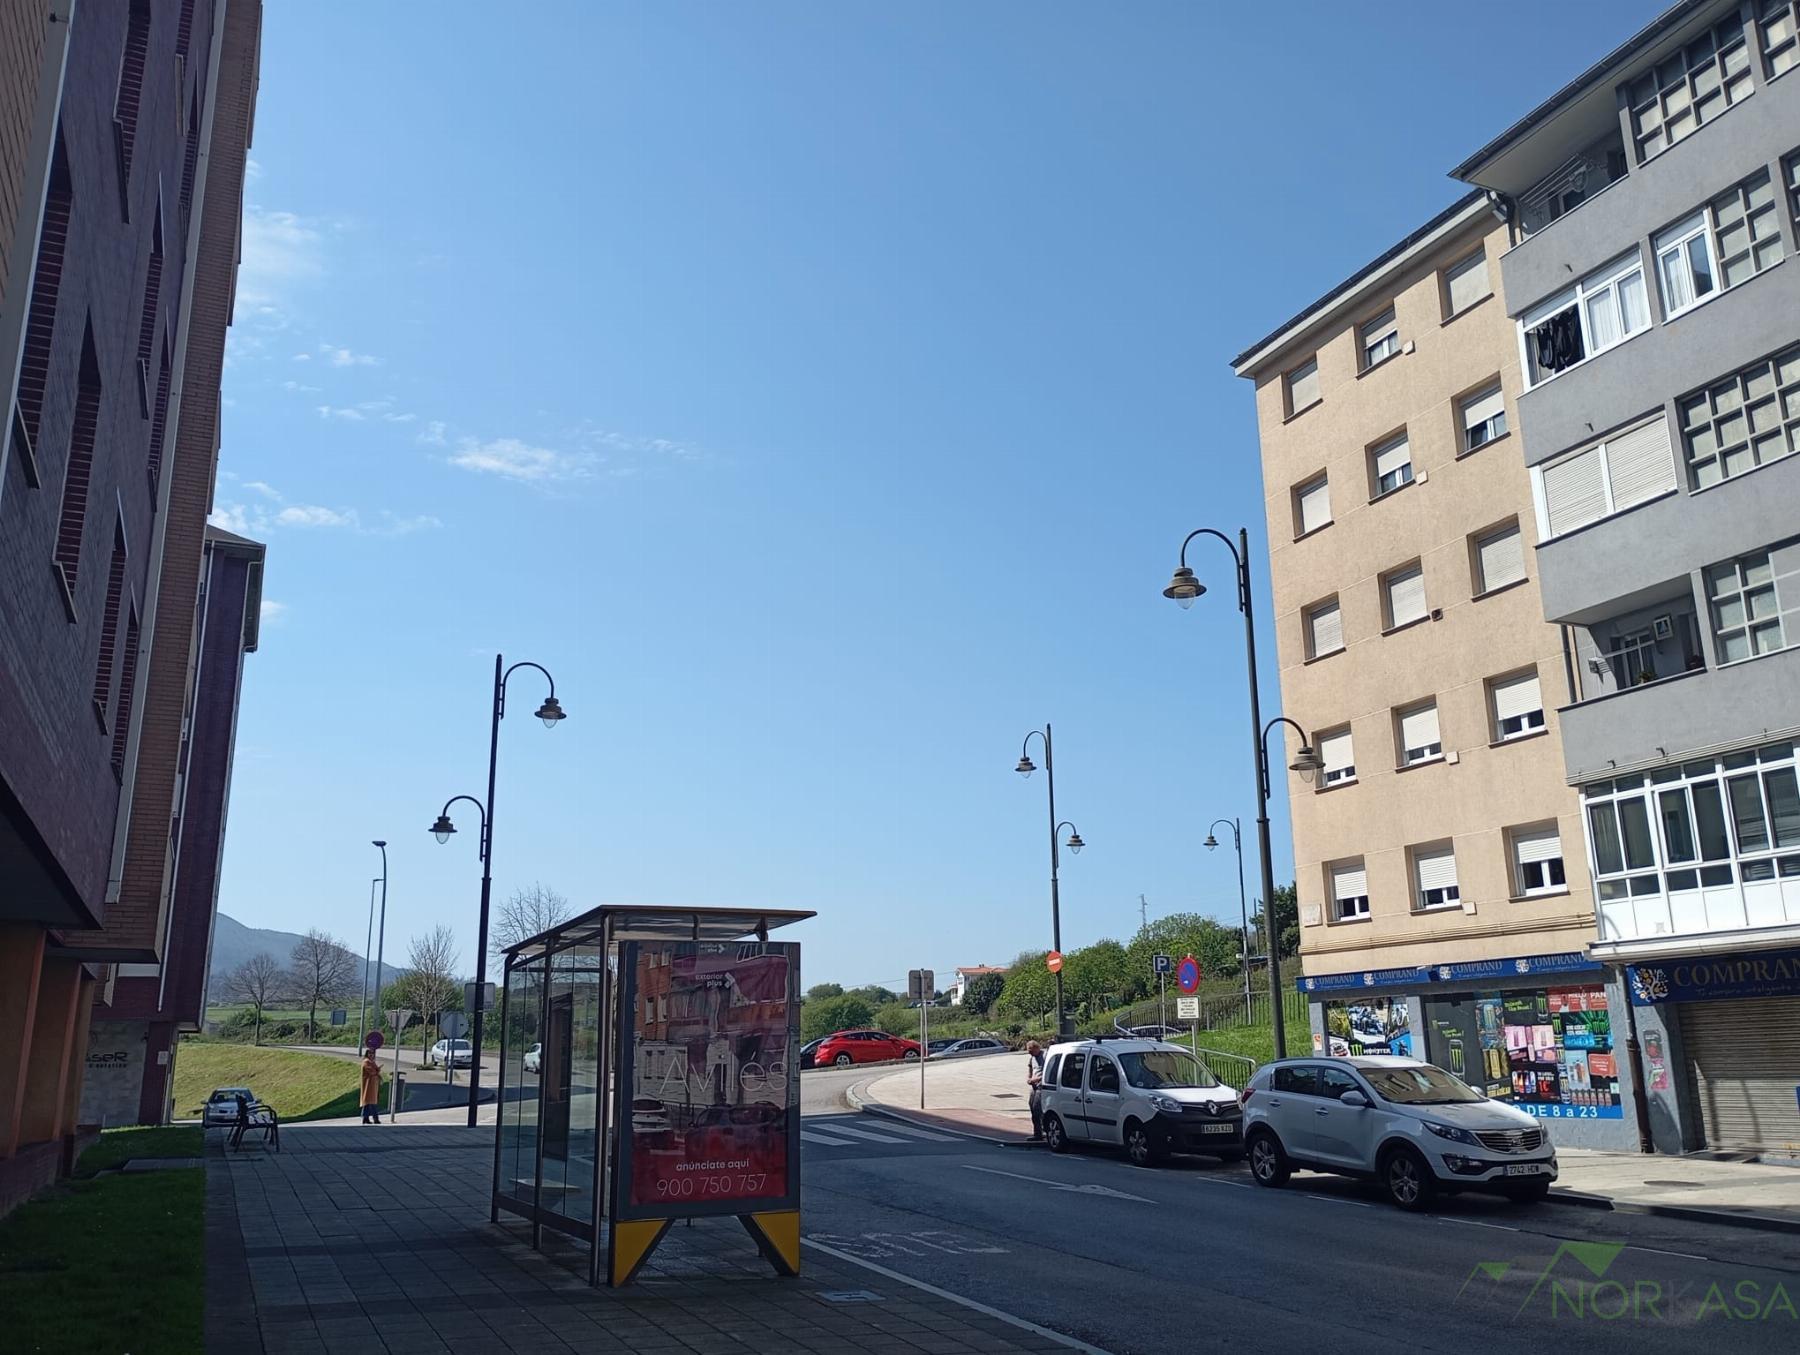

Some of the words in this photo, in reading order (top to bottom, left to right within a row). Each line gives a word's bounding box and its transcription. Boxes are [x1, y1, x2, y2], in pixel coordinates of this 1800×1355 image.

[1156, 957, 1168, 970] P
[1451, 961, 1504, 974] COMPRAND
[695, 973, 723, 981] exterior
[707, 979, 723, 987] plus
[659, 1051, 787, 1095] Avilés
[1527, 1105, 1547, 1117] DE
[1552, 1105, 1561, 1117] 8
[1566, 1108, 1574, 1117] a
[1580, 1105, 1598, 1118] 23
[676, 1160, 726, 1171] anúnciate
[728, 1158, 750, 1170] aquí
[657, 1178, 693, 1196] 900
[700, 1176, 731, 1193] 750
[738, 1173, 767, 1192] 757
